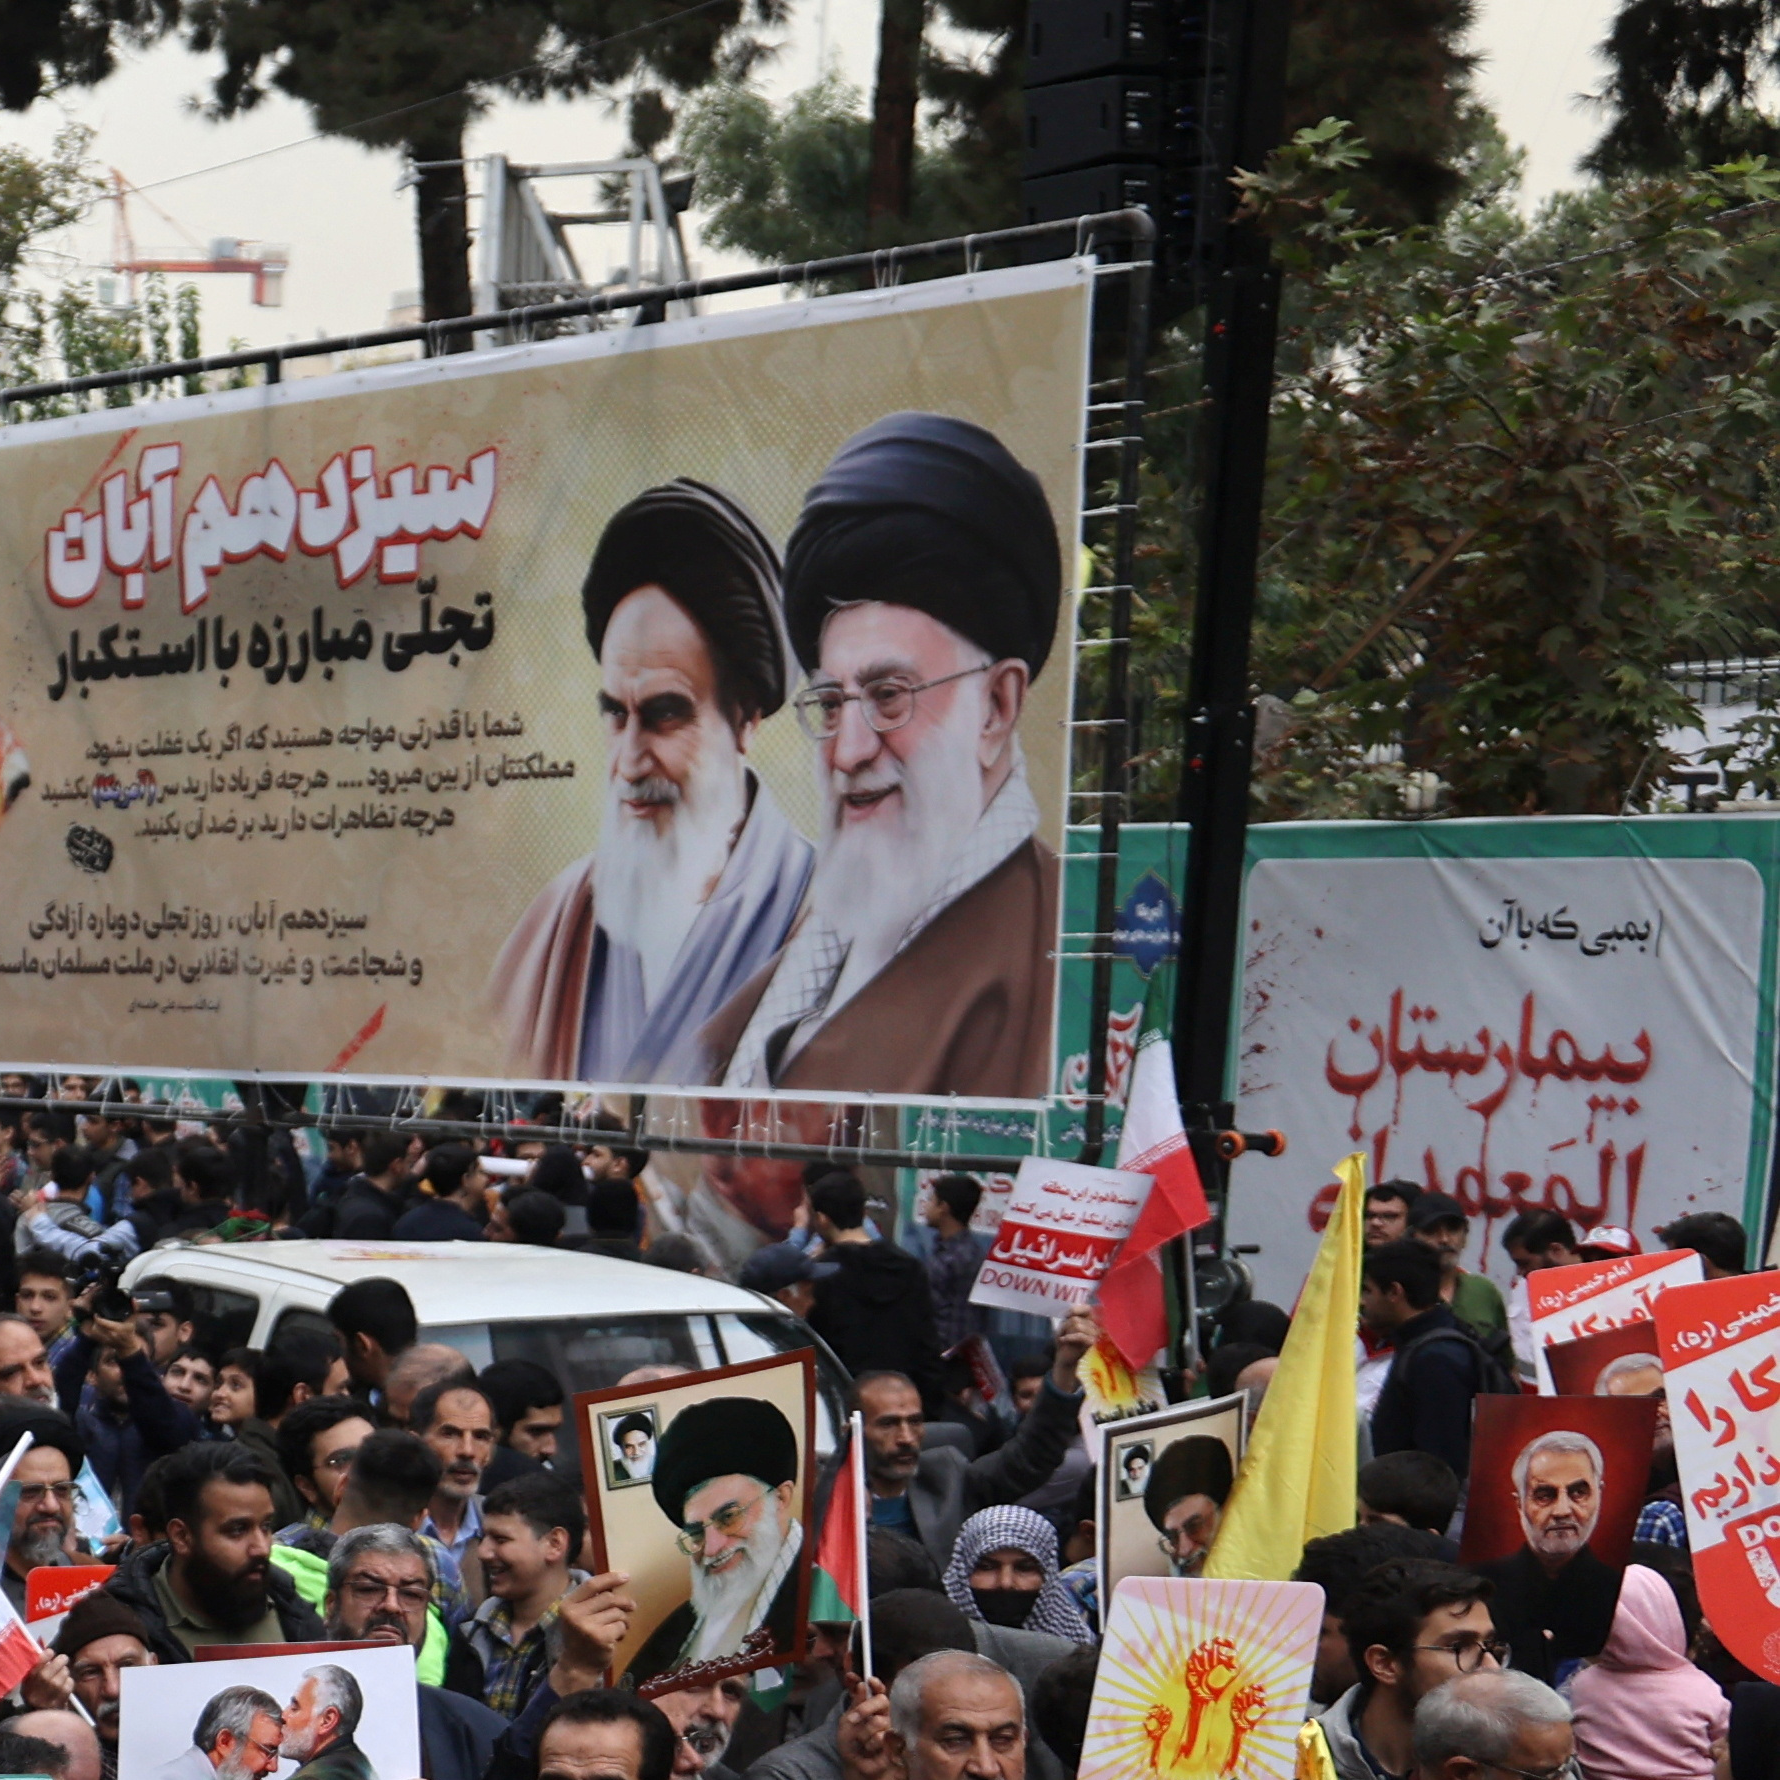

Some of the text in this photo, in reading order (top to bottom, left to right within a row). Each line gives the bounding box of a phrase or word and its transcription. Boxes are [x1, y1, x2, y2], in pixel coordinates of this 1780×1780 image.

[45, 440, 498, 613] سیزدهم آبان
[47, 617, 207, 701] استکبار
[213, 614, 239, 689] با
[247, 605, 373, 685] مبارزه
[137, 709, 523, 759] شما با قدرتی مواجه هستید که اگر یک غفلت
[41, 751, 575, 807] مملکتتان از بین میرود هرچه فریاد دارید سر بکشید
[184, 807, 204, 840] آن
[207, 809, 237, 835] ضد
[236, 817, 255, 841] بر
[259, 806, 305, 840] دارید
[311, 803, 397, 838] تظاهرات
[400, 806, 455, 838] هرچه
[28, 899, 367, 941] سیزدهم روز تجلی دوباره آزادگی
[1479, 898, 1650, 956] بمبی که با آن
[41, 946, 111, 980] مسلمان
[114, 946, 153, 975] ملت
[154, 955, 177, 984] در
[179, 946, 238, 983] انقلابی
[243, 948, 296, 985] غیرت
[300, 957, 314, 985] و
[1324, 986, 1653, 1119] بیمارستان
[993, 1230, 1092, 1270] اسرائیل
[980, 1268, 1091, 1304] DOWN WIT
[1568, 1260, 1632, 1301] امام خمینی
[1684, 1388, 1737, 1447] را
[1691, 1446, 1780, 1520] ذاریم
